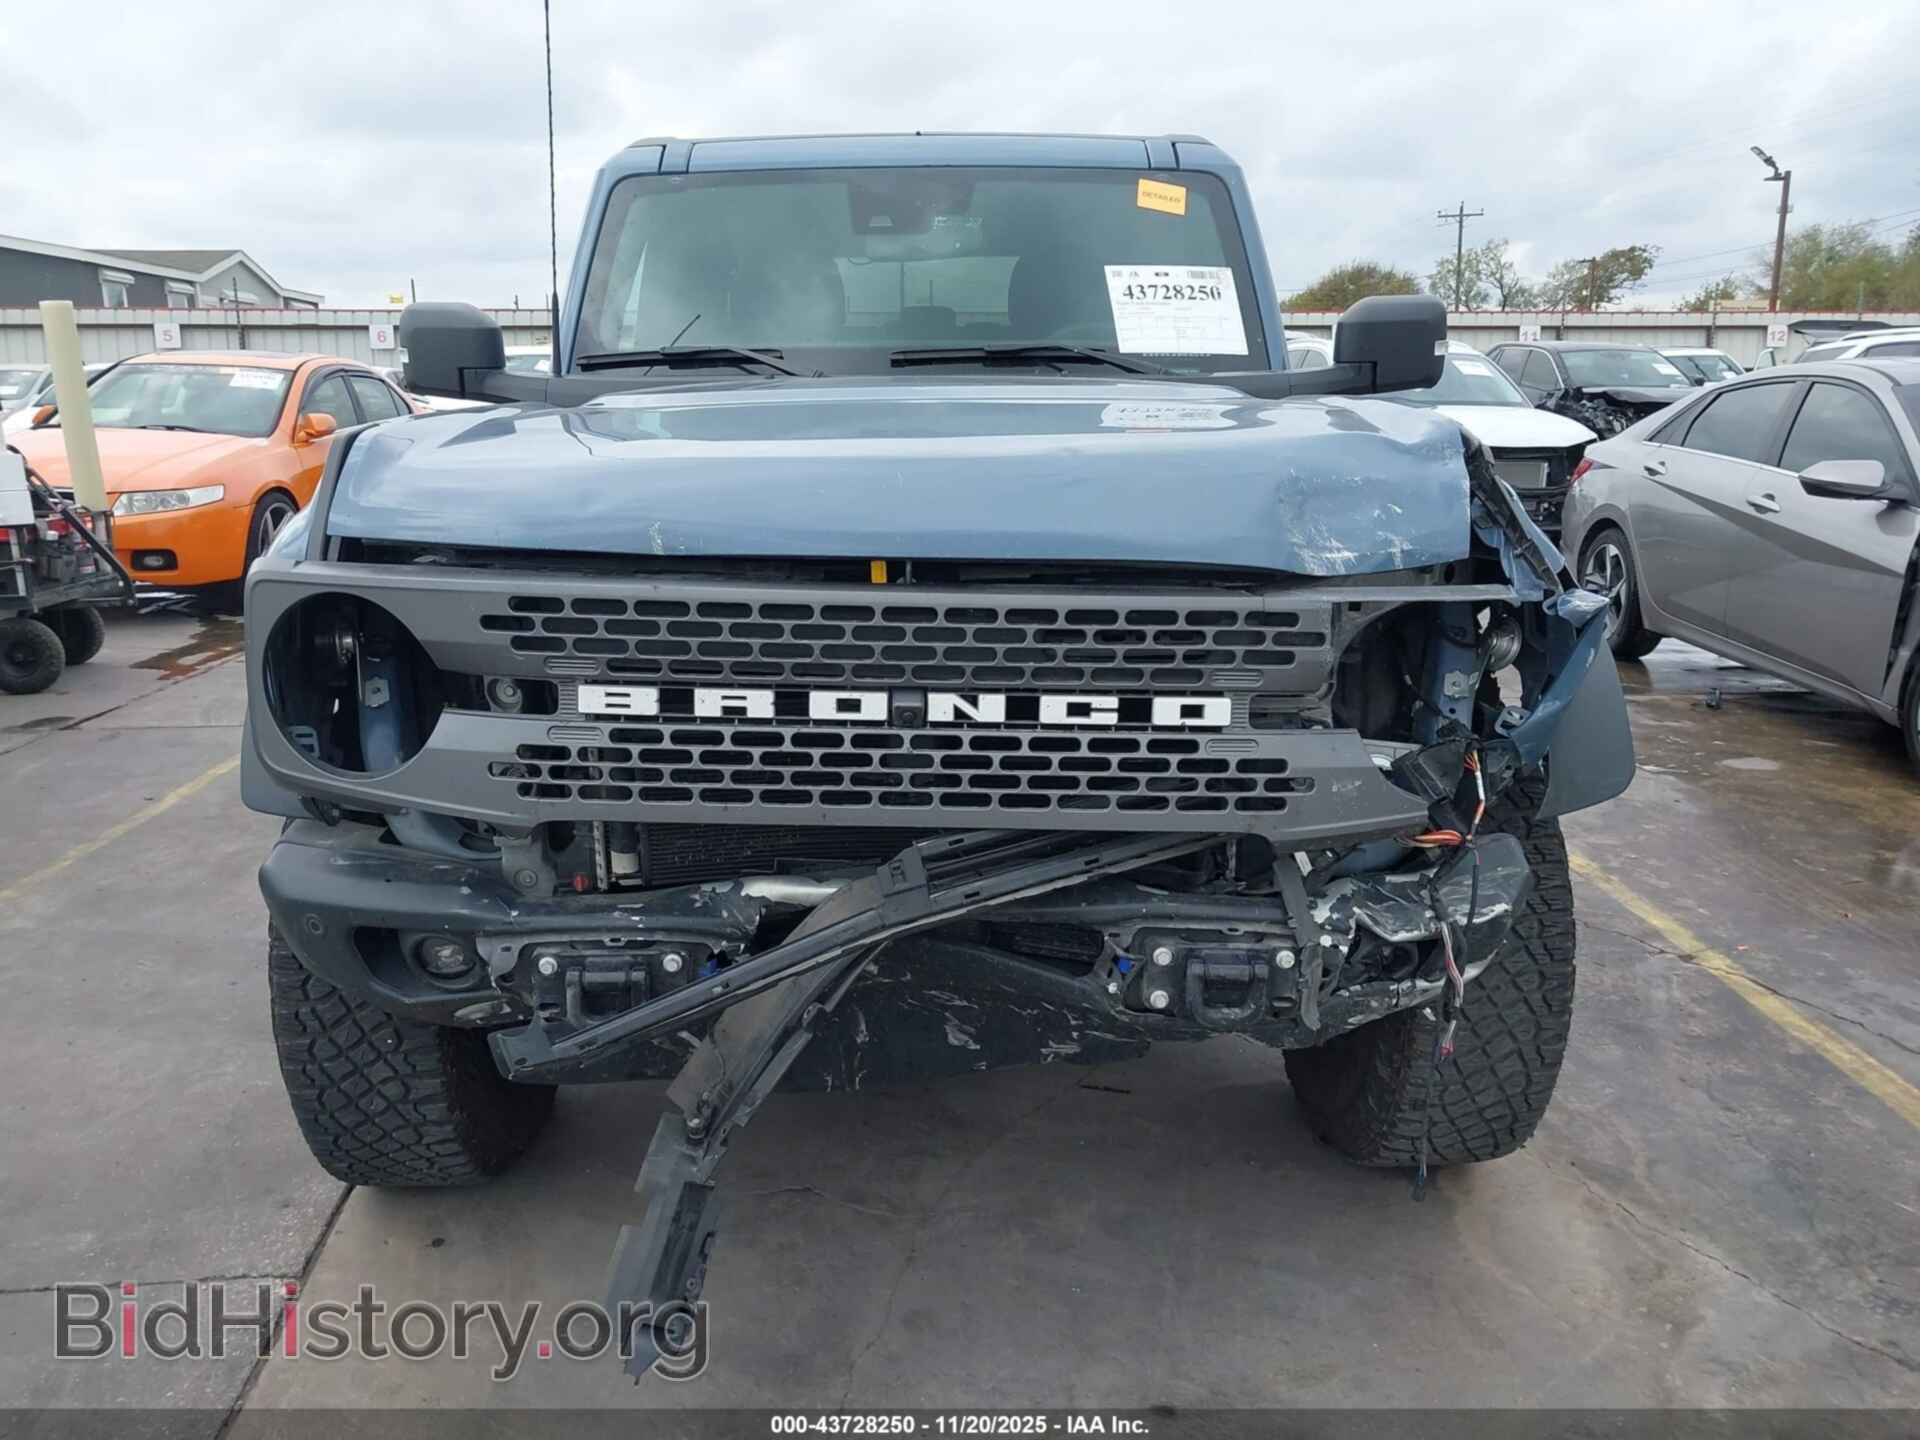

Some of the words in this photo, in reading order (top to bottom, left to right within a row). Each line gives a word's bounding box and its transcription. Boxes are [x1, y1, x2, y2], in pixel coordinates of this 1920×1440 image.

[1123, 284, 1222, 301] 43728250
[162, 329, 173, 342] 5
[376, 330, 386, 343] 6
[1768, 330, 1785, 342] 12
[578, 684, 1231, 727] BRONCO
